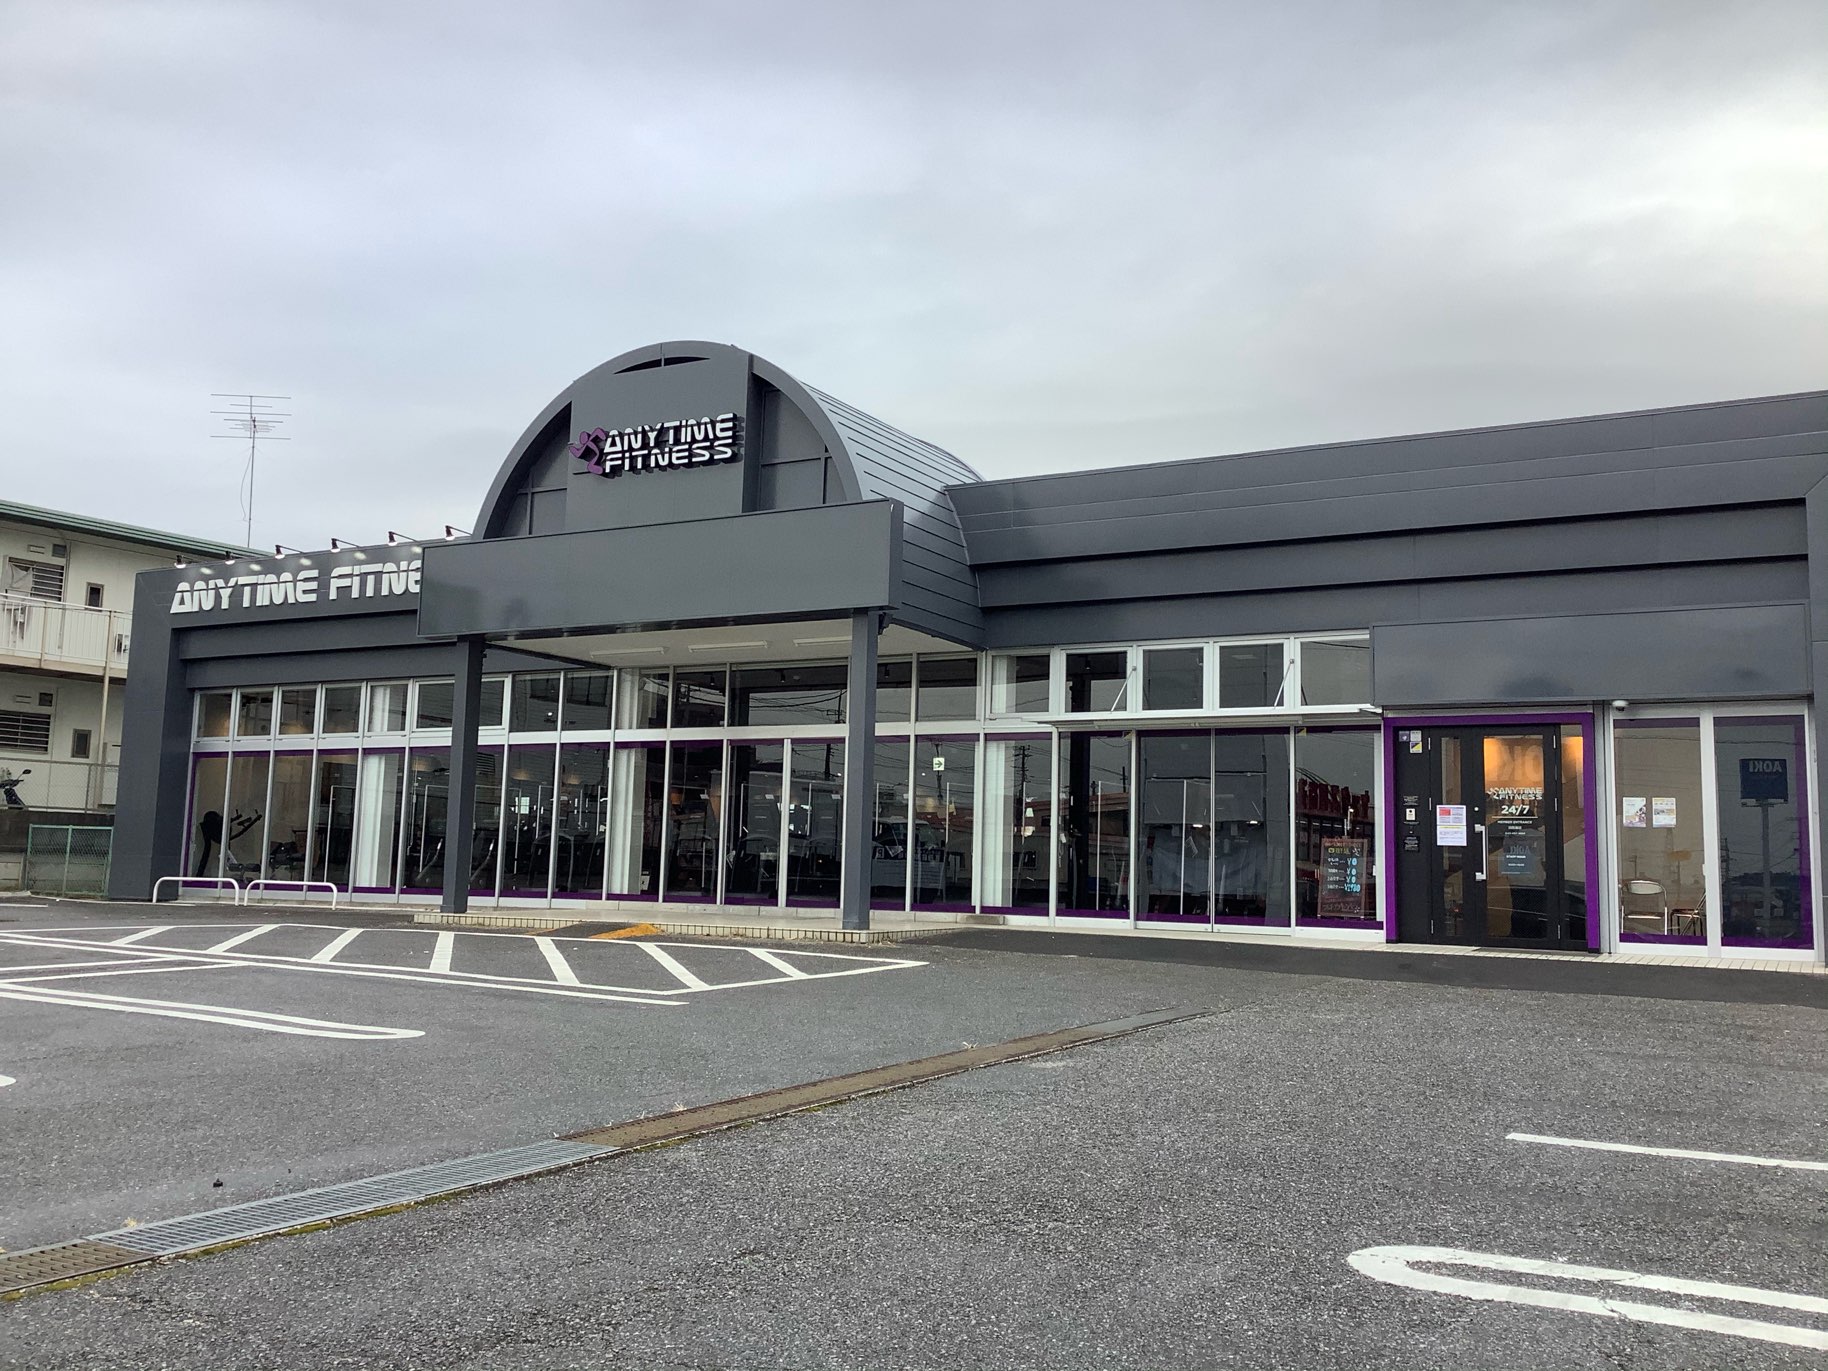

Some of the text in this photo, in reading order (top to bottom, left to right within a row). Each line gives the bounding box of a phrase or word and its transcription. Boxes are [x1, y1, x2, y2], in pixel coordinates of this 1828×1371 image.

[603, 412, 734, 453] ANYTIME
[605, 439, 733, 473] FITNESS
[170, 569, 318, 614] ANYTIME
[1501, 804, 1529, 815] 24/7
